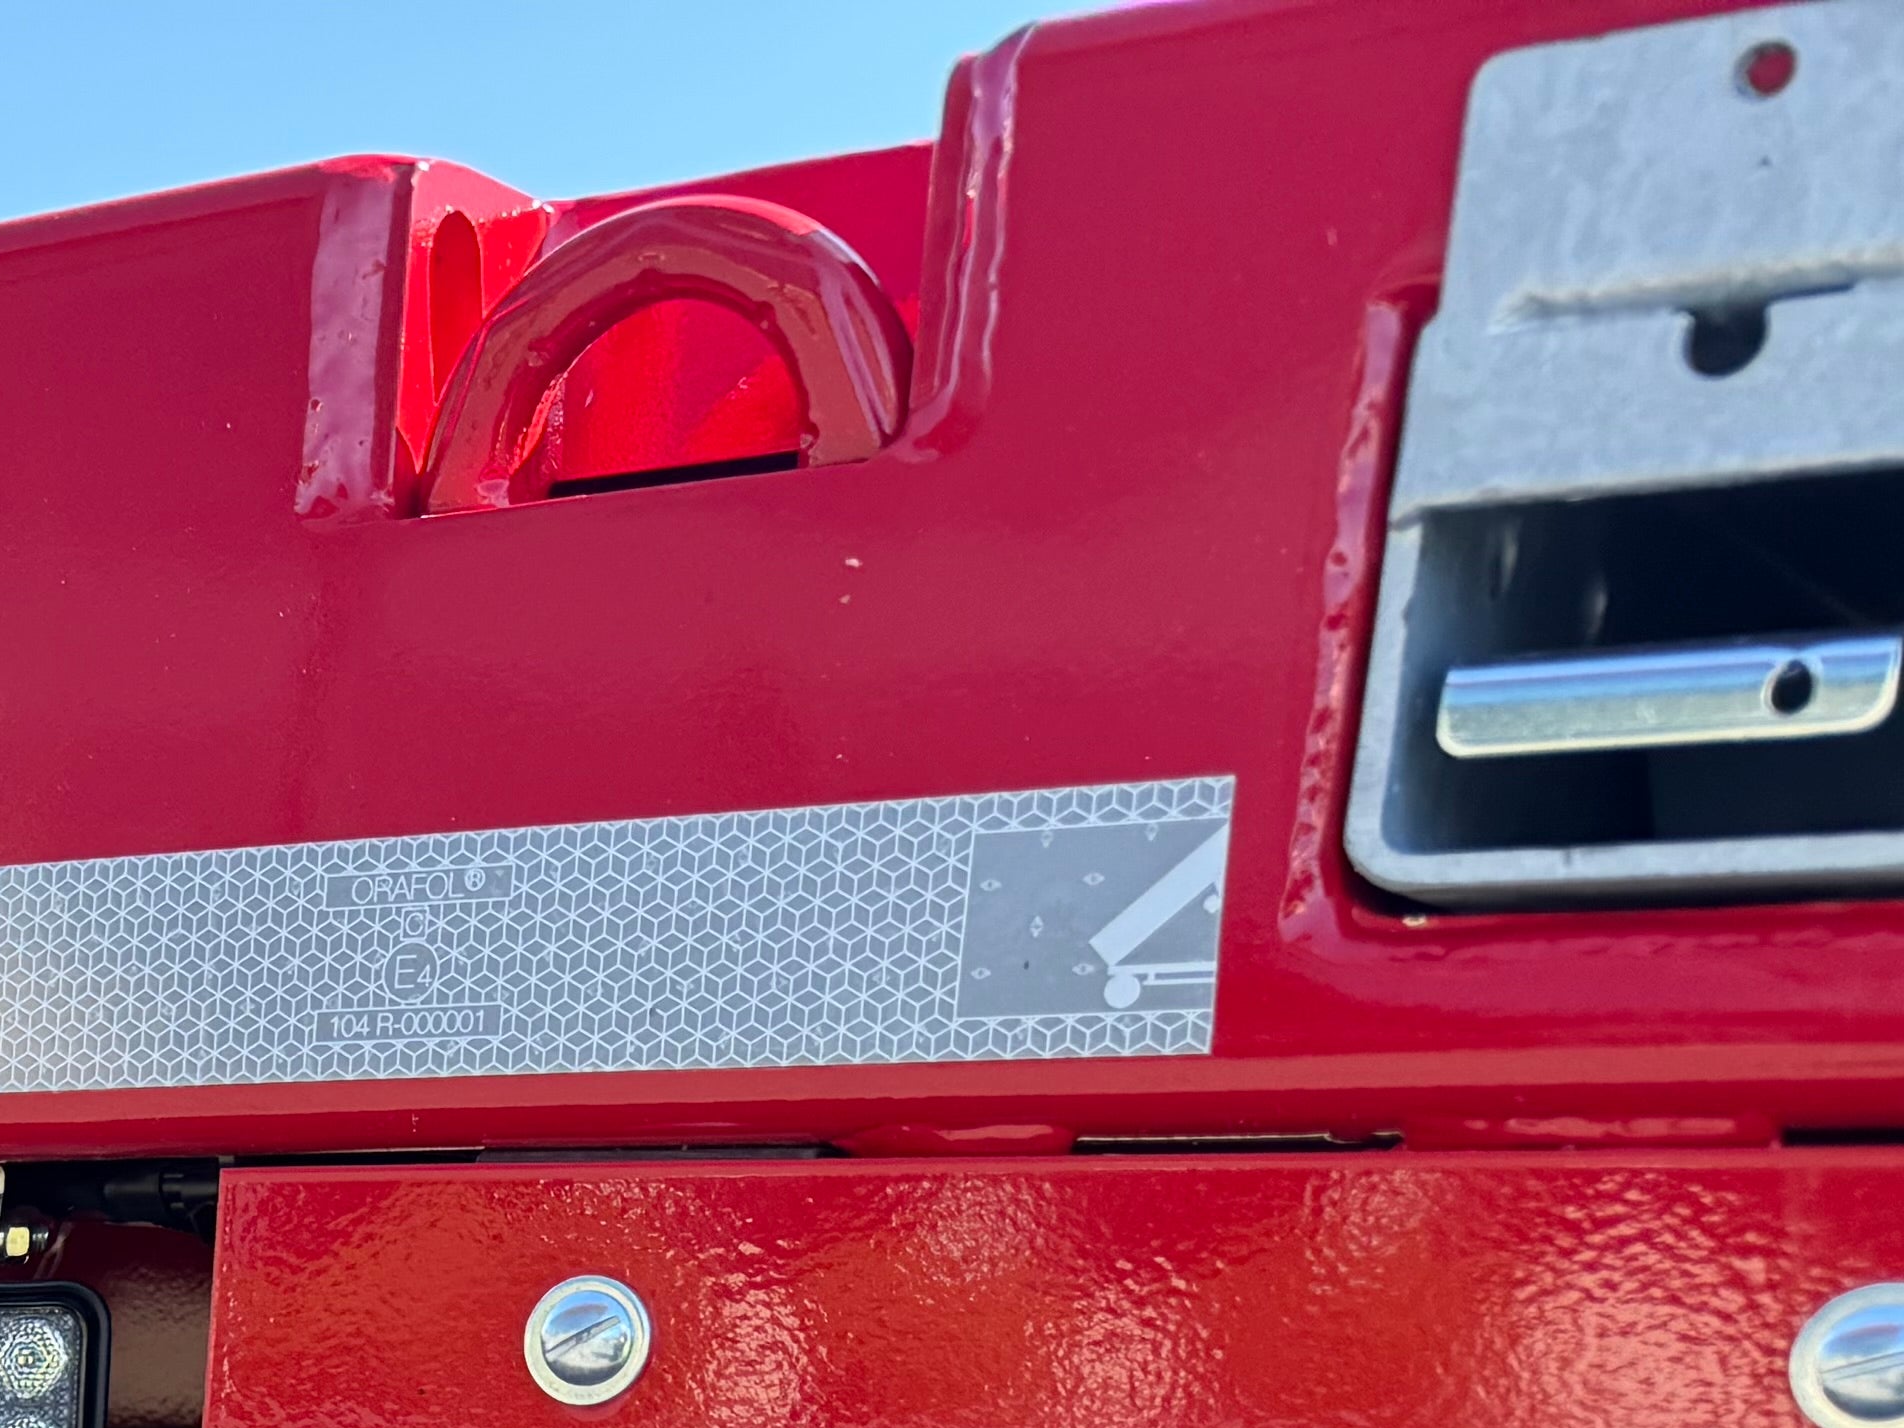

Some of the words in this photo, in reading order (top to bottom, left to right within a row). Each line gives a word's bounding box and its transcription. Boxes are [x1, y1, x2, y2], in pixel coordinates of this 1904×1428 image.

[405, 912, 424, 936] C
[394, 954, 433, 990] E4
[330, 1014, 370, 1038] 104
[376, 1009, 485, 1037] R-000001
